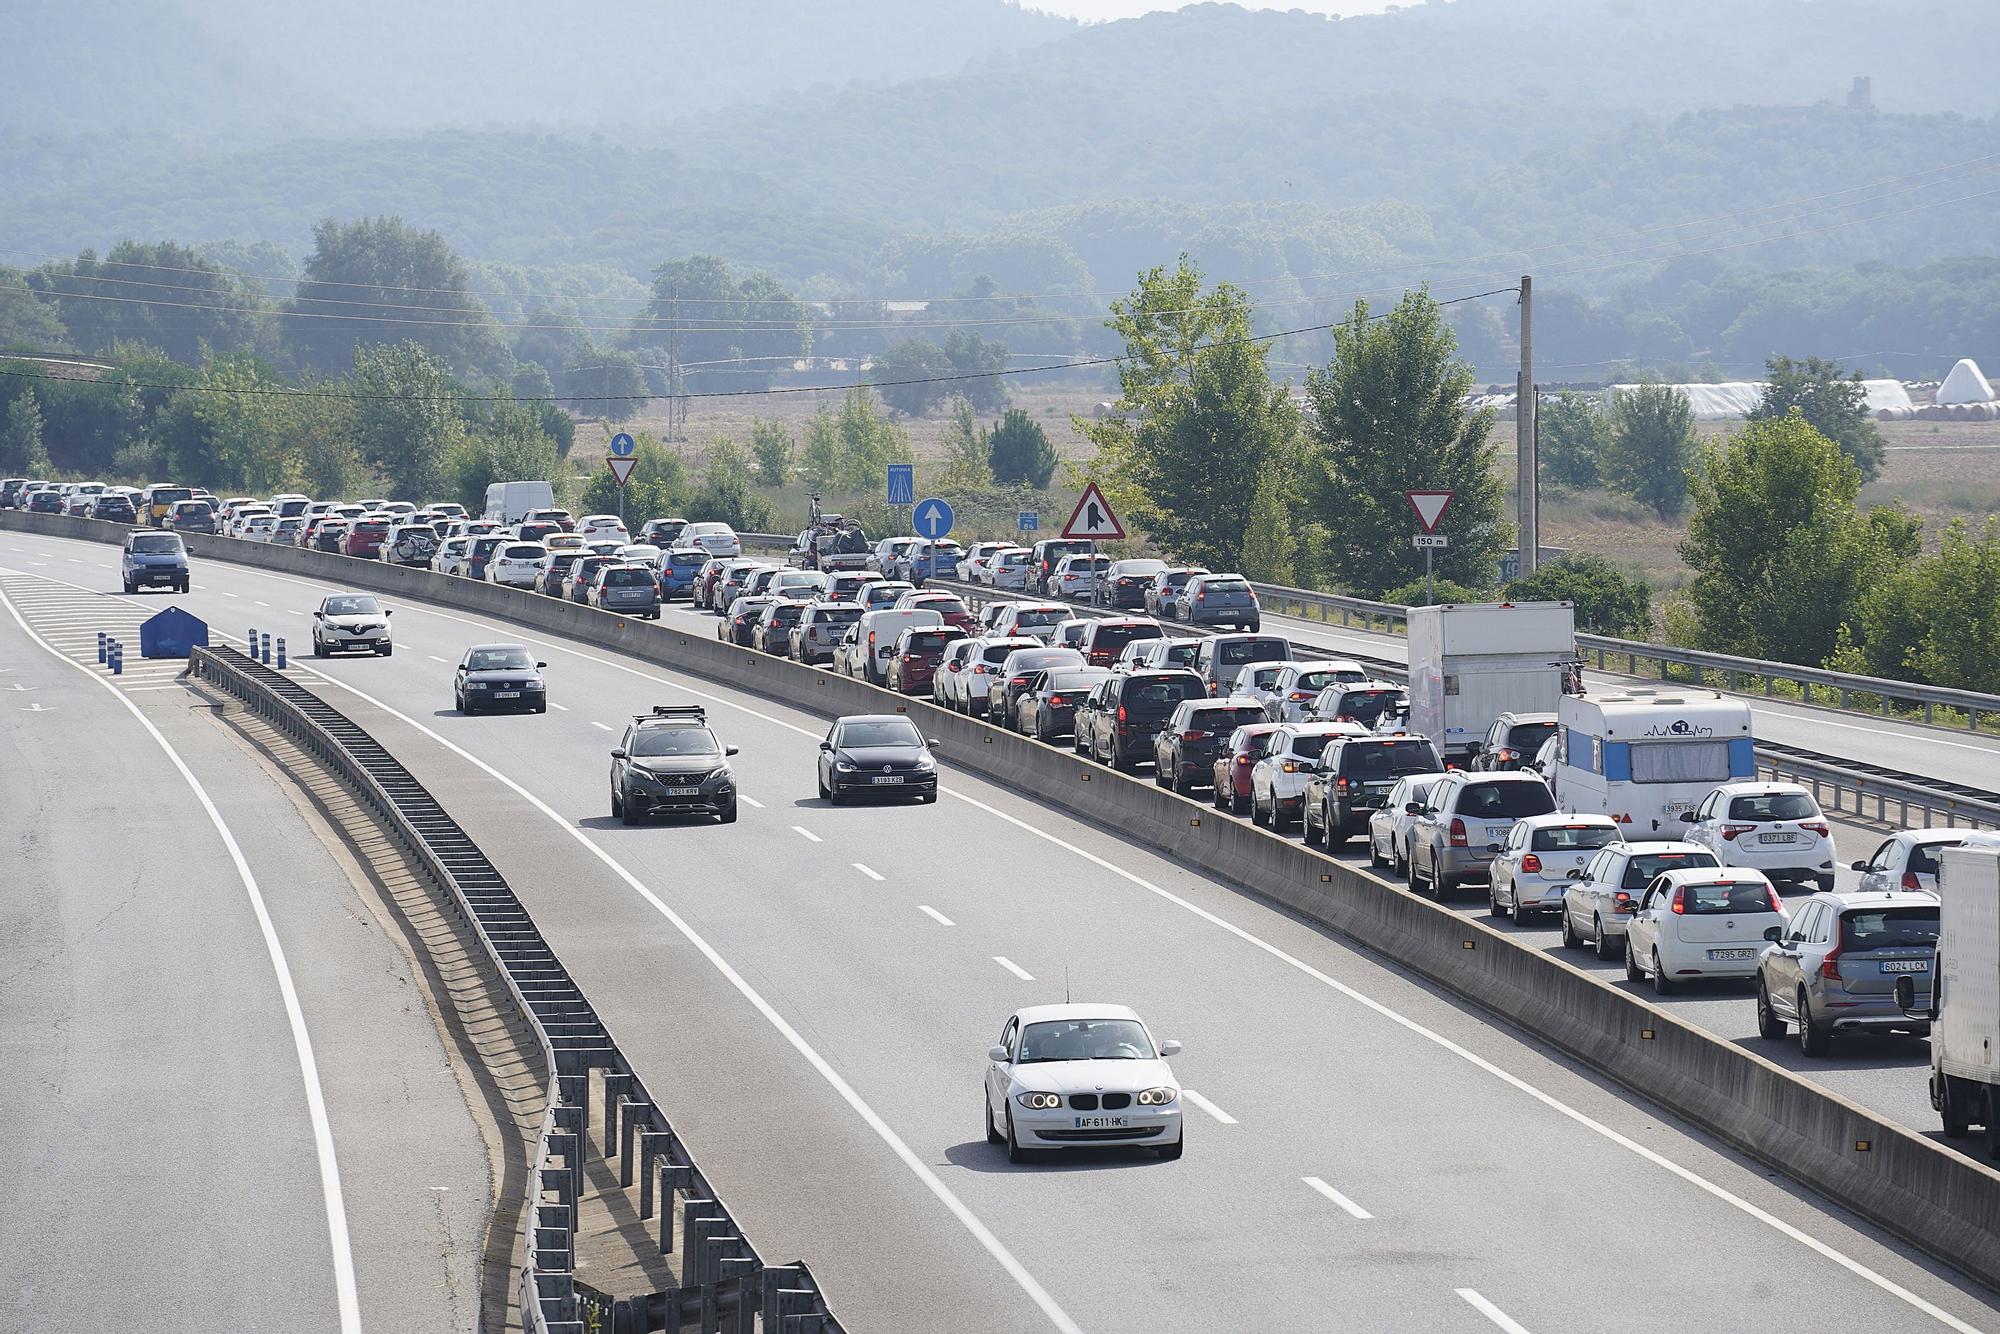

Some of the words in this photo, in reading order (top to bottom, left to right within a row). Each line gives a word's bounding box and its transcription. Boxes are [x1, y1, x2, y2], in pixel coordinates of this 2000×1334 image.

[1715, 951, 1736, 959] 7295
[1737, 950, 1752, 958] GRZ
[1885, 962, 1907, 971] 6024
[1909, 961, 1926, 970] LCK
